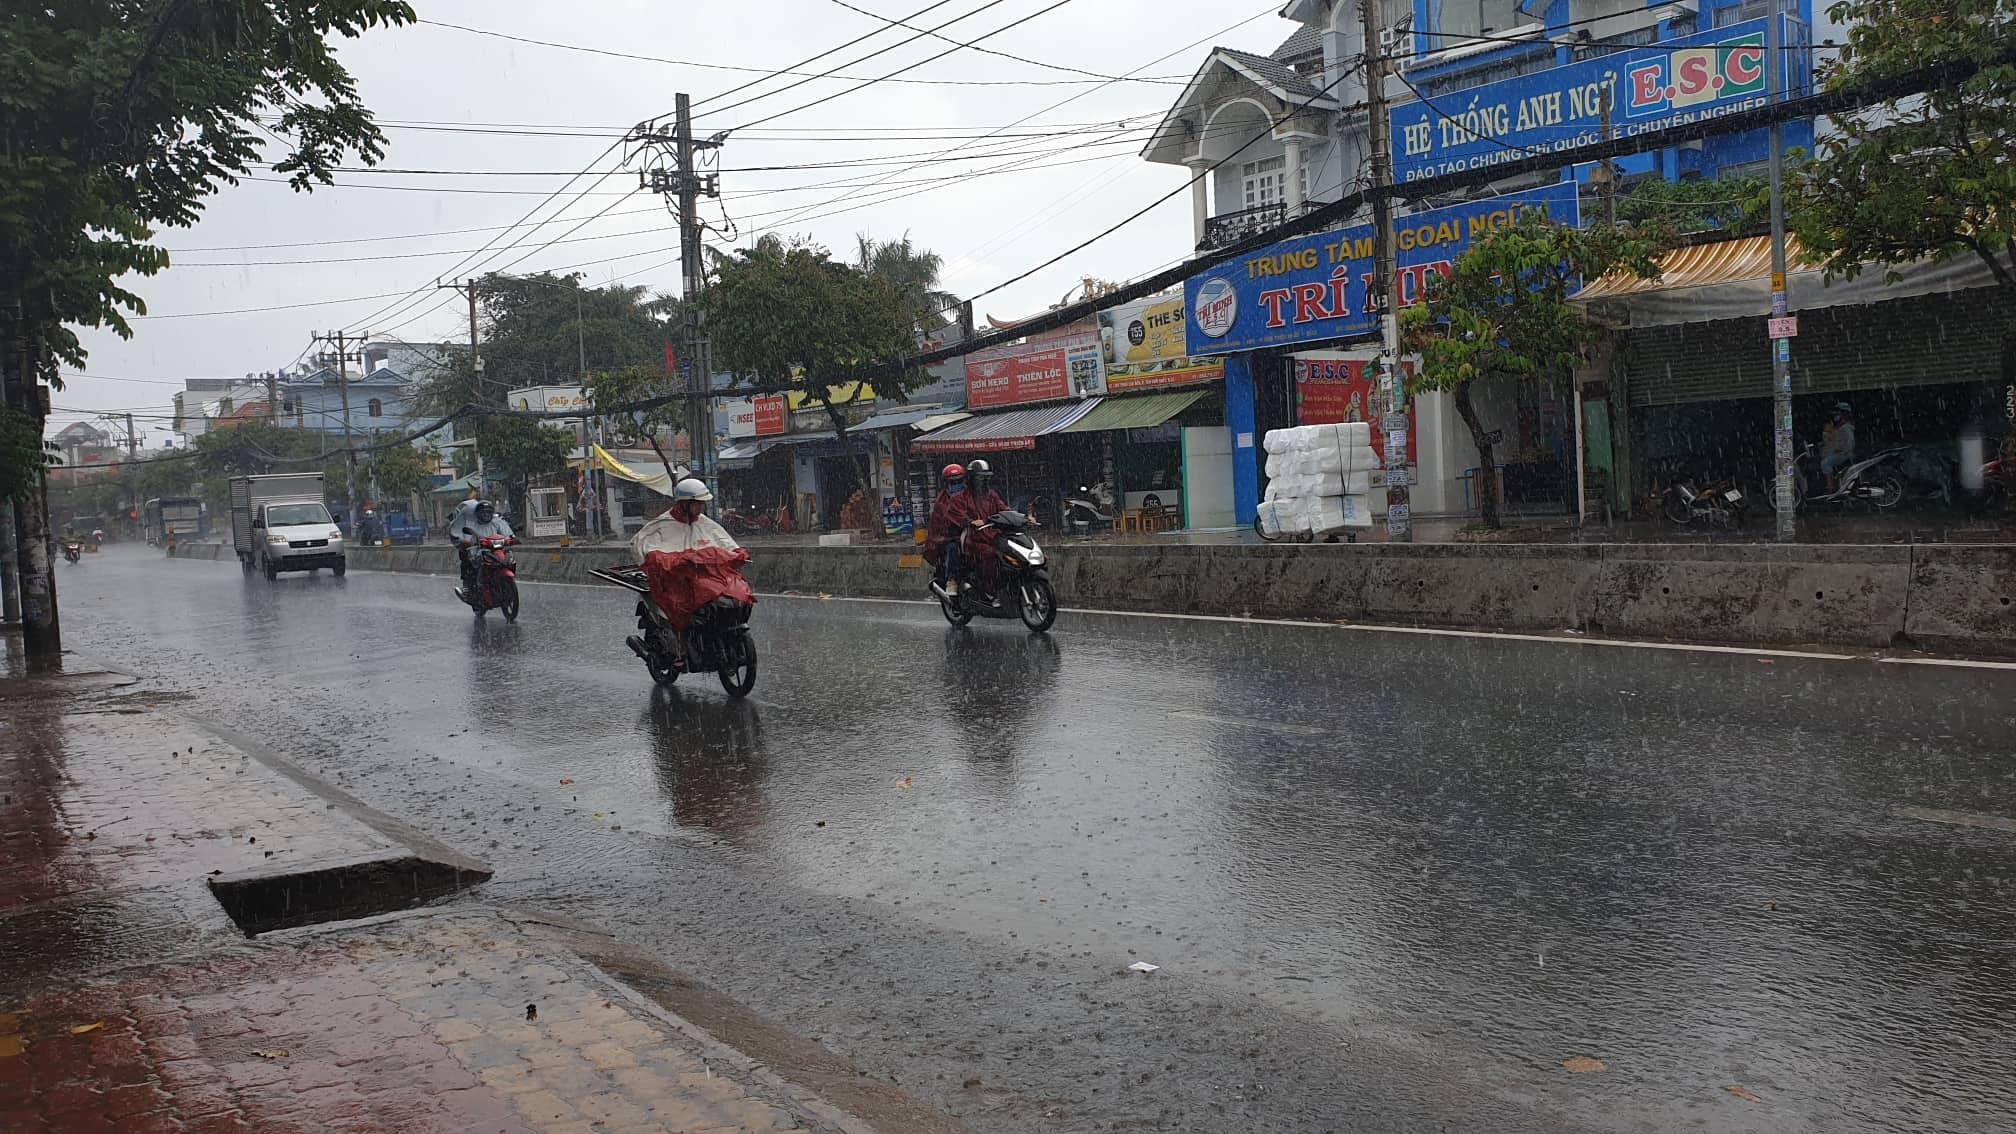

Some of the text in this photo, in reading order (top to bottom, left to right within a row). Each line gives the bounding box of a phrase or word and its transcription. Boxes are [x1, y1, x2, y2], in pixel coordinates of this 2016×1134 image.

[1404, 113, 1431, 158] HỆ
[1438, 98, 1509, 148] THỐNG
[1516, 89, 1561, 132] ANH
[1630, 43, 1763, 107] E.S.C
[1405, 165, 1435, 182] ĐÀO
[1554, 131, 1599, 152] QUỐC
[1628, 111, 1695, 136] CHUYÊN
[1246, 248, 1319, 279] TRUNG
[1325, 234, 1374, 266] TÂM
[1396, 217, 1461, 251] GOẠI
[1147, 312, 1170, 329] THE
[1258, 264, 1350, 330] TRÍ
